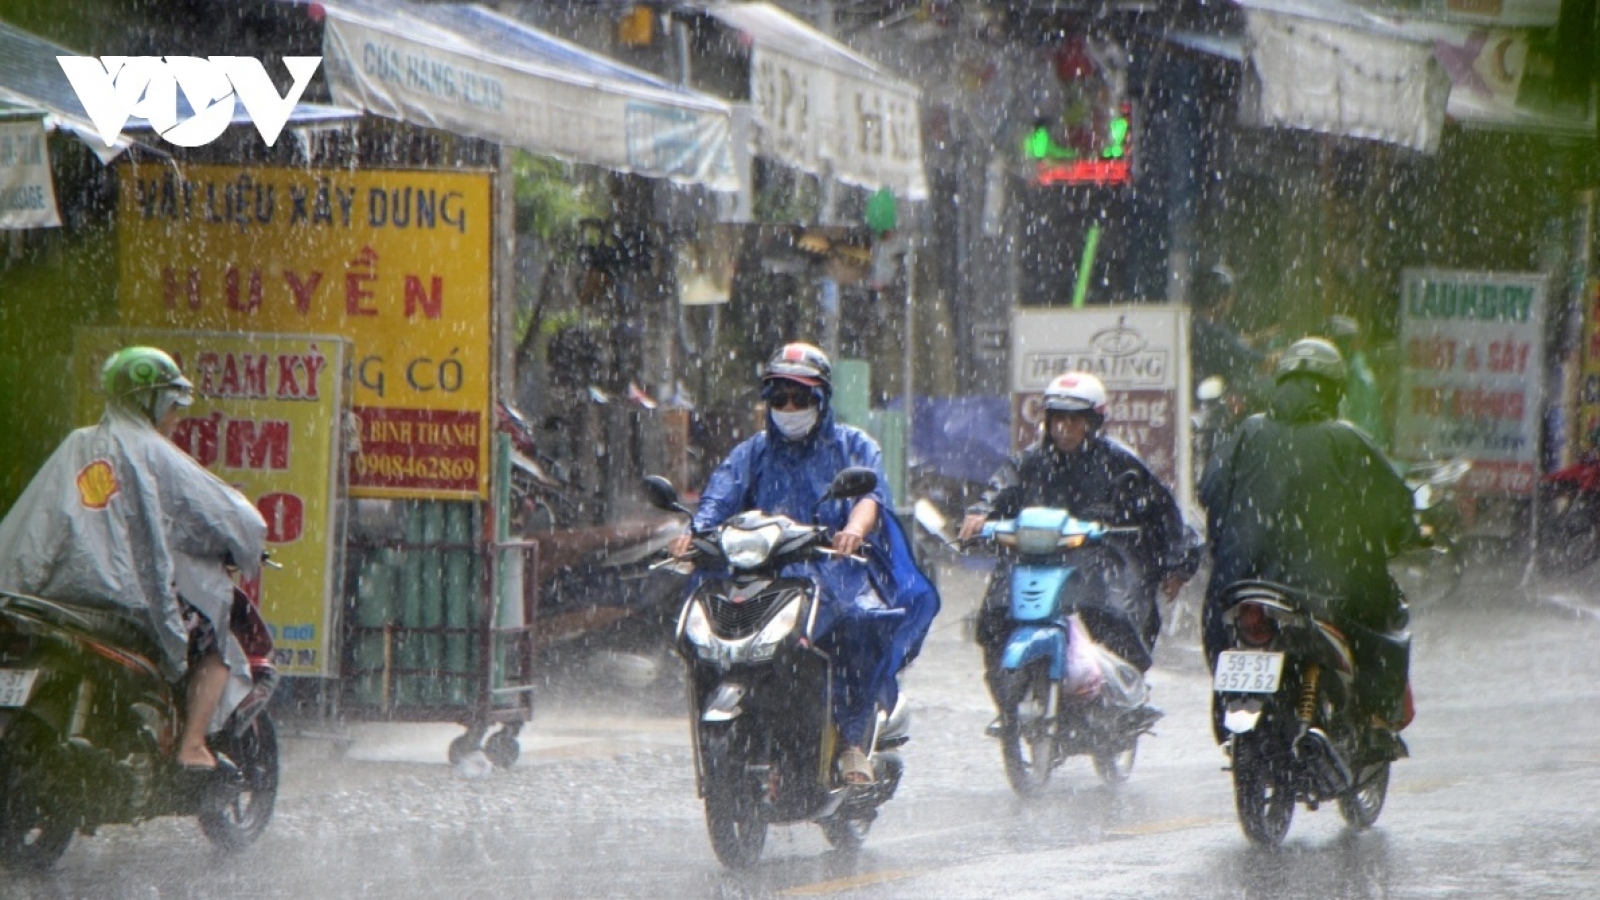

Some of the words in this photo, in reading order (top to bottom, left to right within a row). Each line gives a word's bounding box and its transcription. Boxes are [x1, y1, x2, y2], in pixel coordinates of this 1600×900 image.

[1408, 280, 1535, 323] LAUNDRY
[198, 352, 270, 399] TAM
[406, 346, 464, 393] CÓ
[1031, 356, 1069, 377] THE
[1076, 354, 1162, 382] DATING
[171, 411, 292, 471] ƠM
[353, 453, 477, 481] 0908462869
[1219, 672, 1275, 690] 357.62
[1227, 655, 1271, 672] 59-S1
